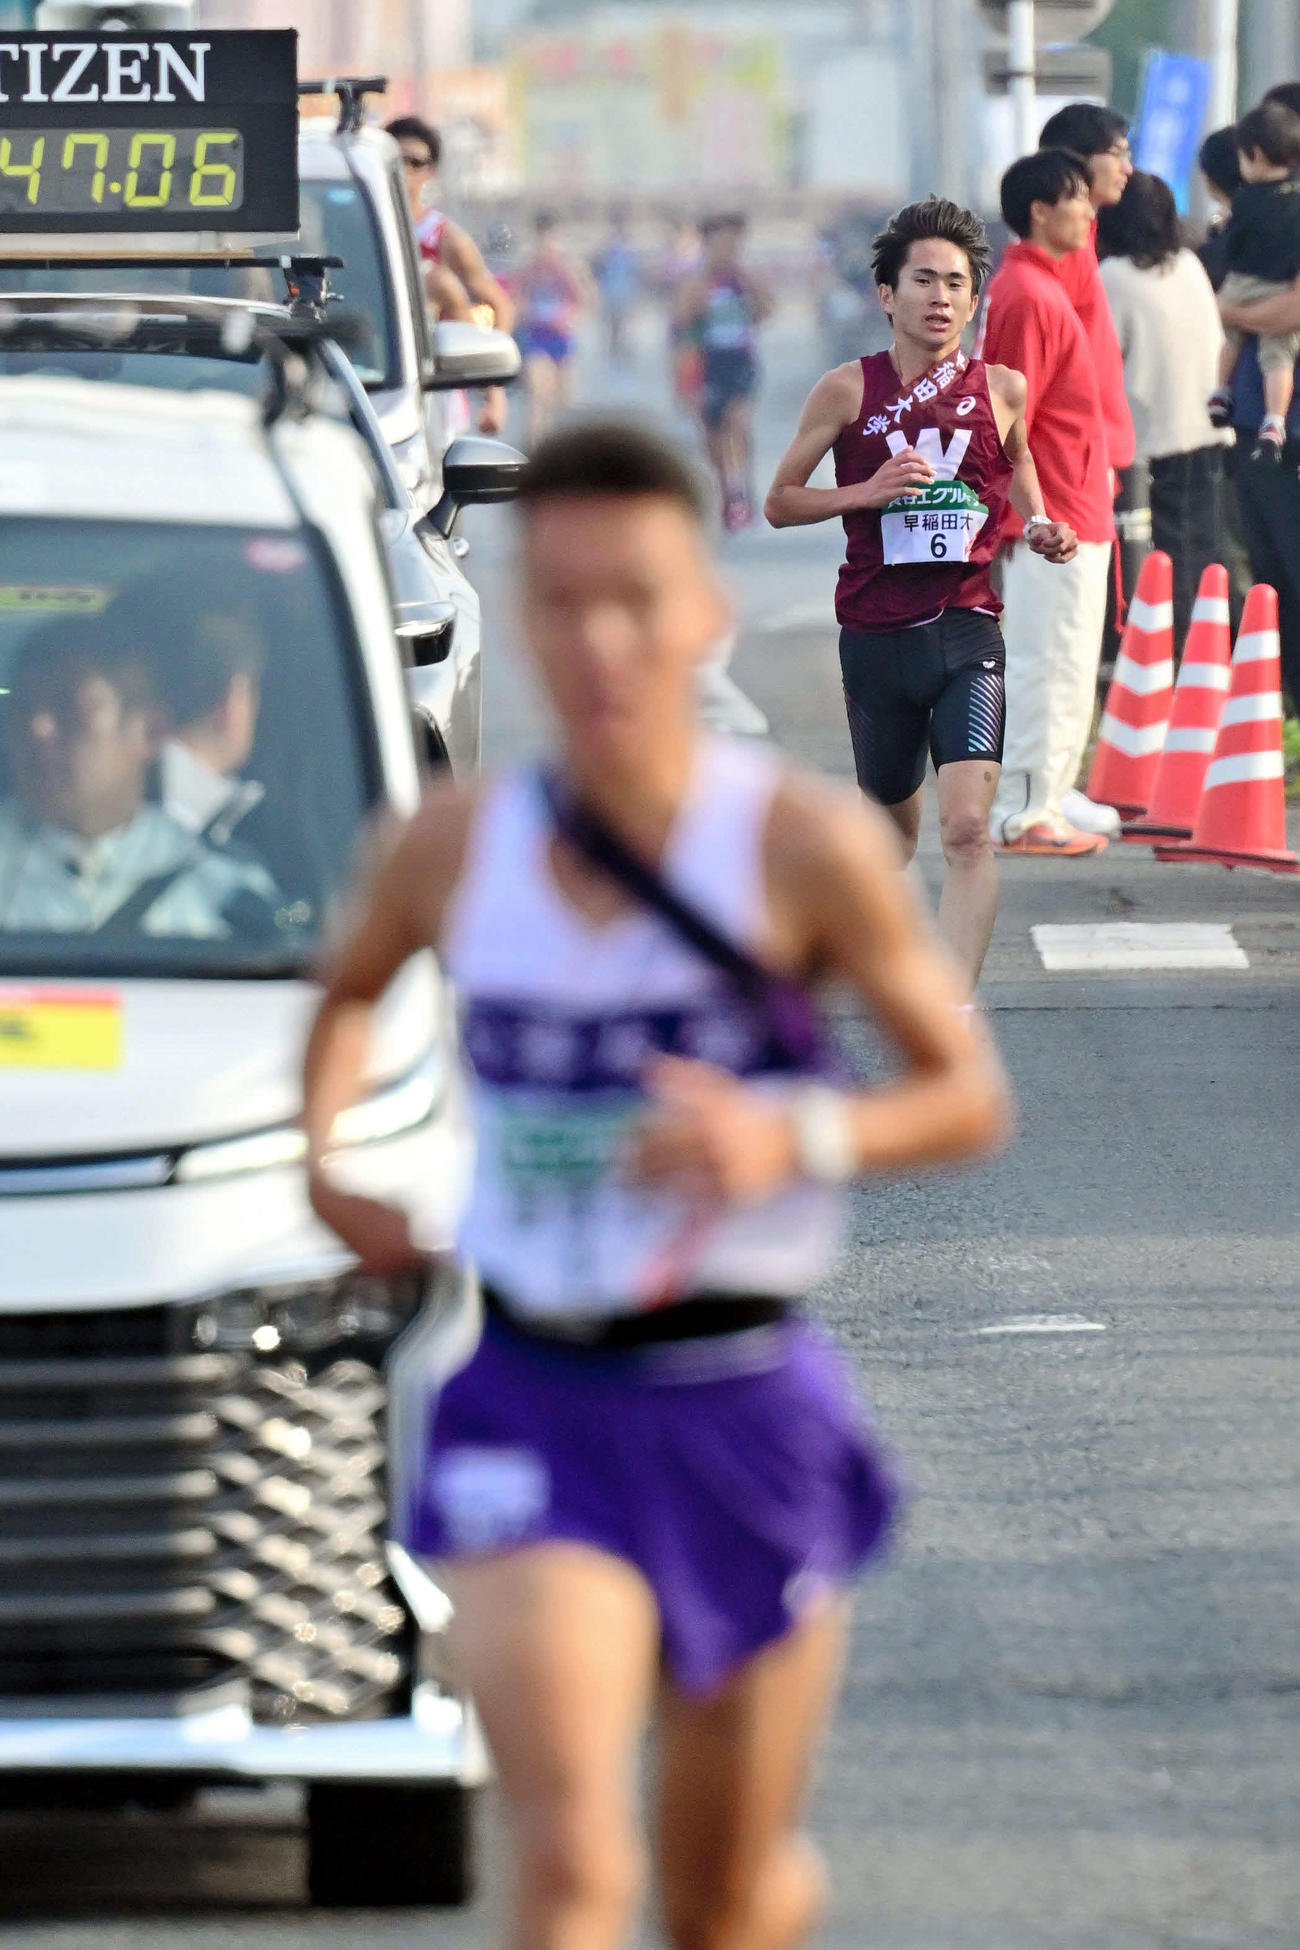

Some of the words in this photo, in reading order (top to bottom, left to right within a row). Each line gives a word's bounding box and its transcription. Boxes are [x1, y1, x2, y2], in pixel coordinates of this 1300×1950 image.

[885, 427, 973, 482] W
[904, 513, 973, 532] 早稲田大
[930, 533, 947, 558] 6
